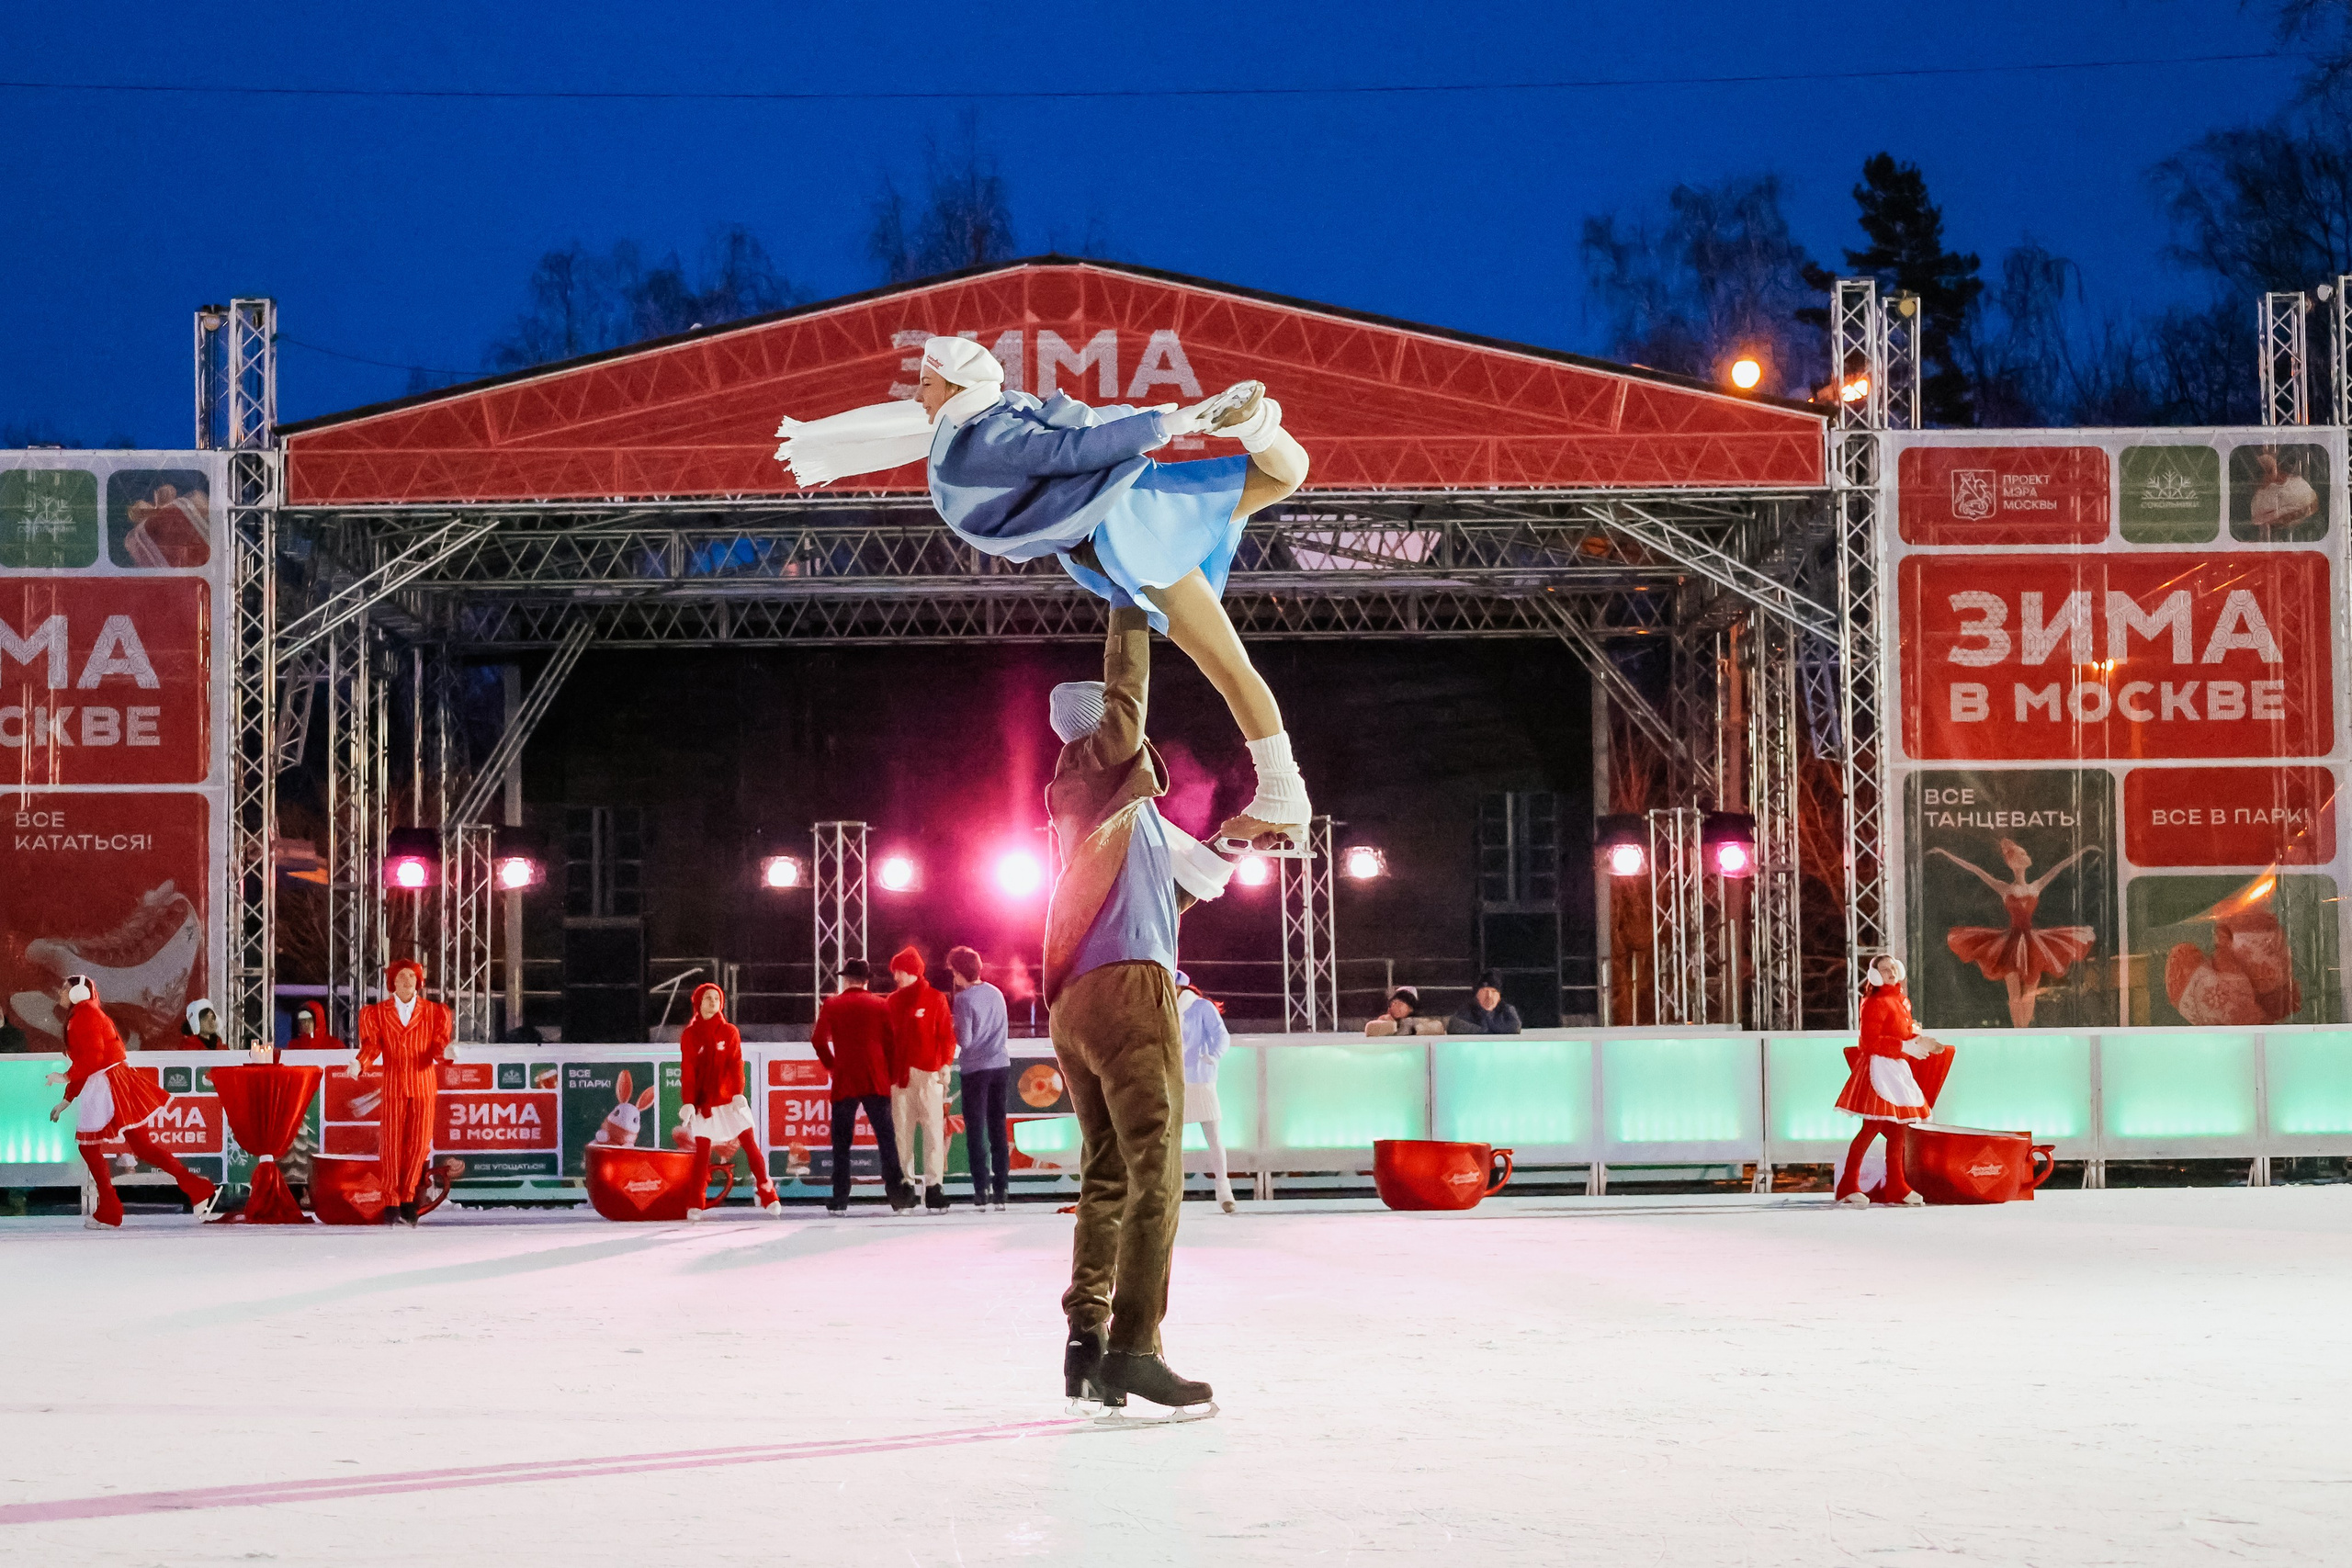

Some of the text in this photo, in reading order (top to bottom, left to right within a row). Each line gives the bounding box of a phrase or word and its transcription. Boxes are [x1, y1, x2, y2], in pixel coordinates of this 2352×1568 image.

[2003, 475, 2051, 485] ПРОЕКТ
[2003, 488, 2038, 497] МЭРА
[2003, 501, 2057, 510] МОСКВЫ
[1947, 590, 2284, 667] ЗИМА
[1950, 680, 2286, 724] В МОСКВЕ
[1924, 789, 1974, 805] ВСЕ
[15, 812, 64, 827] ВСЕ
[1924, 810, 2082, 829] ТАНЦЕВАТЬ!
[2152, 807, 2309, 825] ВСЕ В ПАРК!
[15, 834, 152, 851] КАТАТЬСЯ!
[569, 1069, 591, 1077] ВСЕ
[666, 1068, 682, 1077] ВС
[569, 1079, 611, 1089] В ПАРК!
[449, 1103, 541, 1125] ЗИМА
[449, 1128, 541, 1140] В МОСКВЕ
[785, 1124, 797, 1136] В
[149, 1132, 207, 1144] ОСКВЕ
